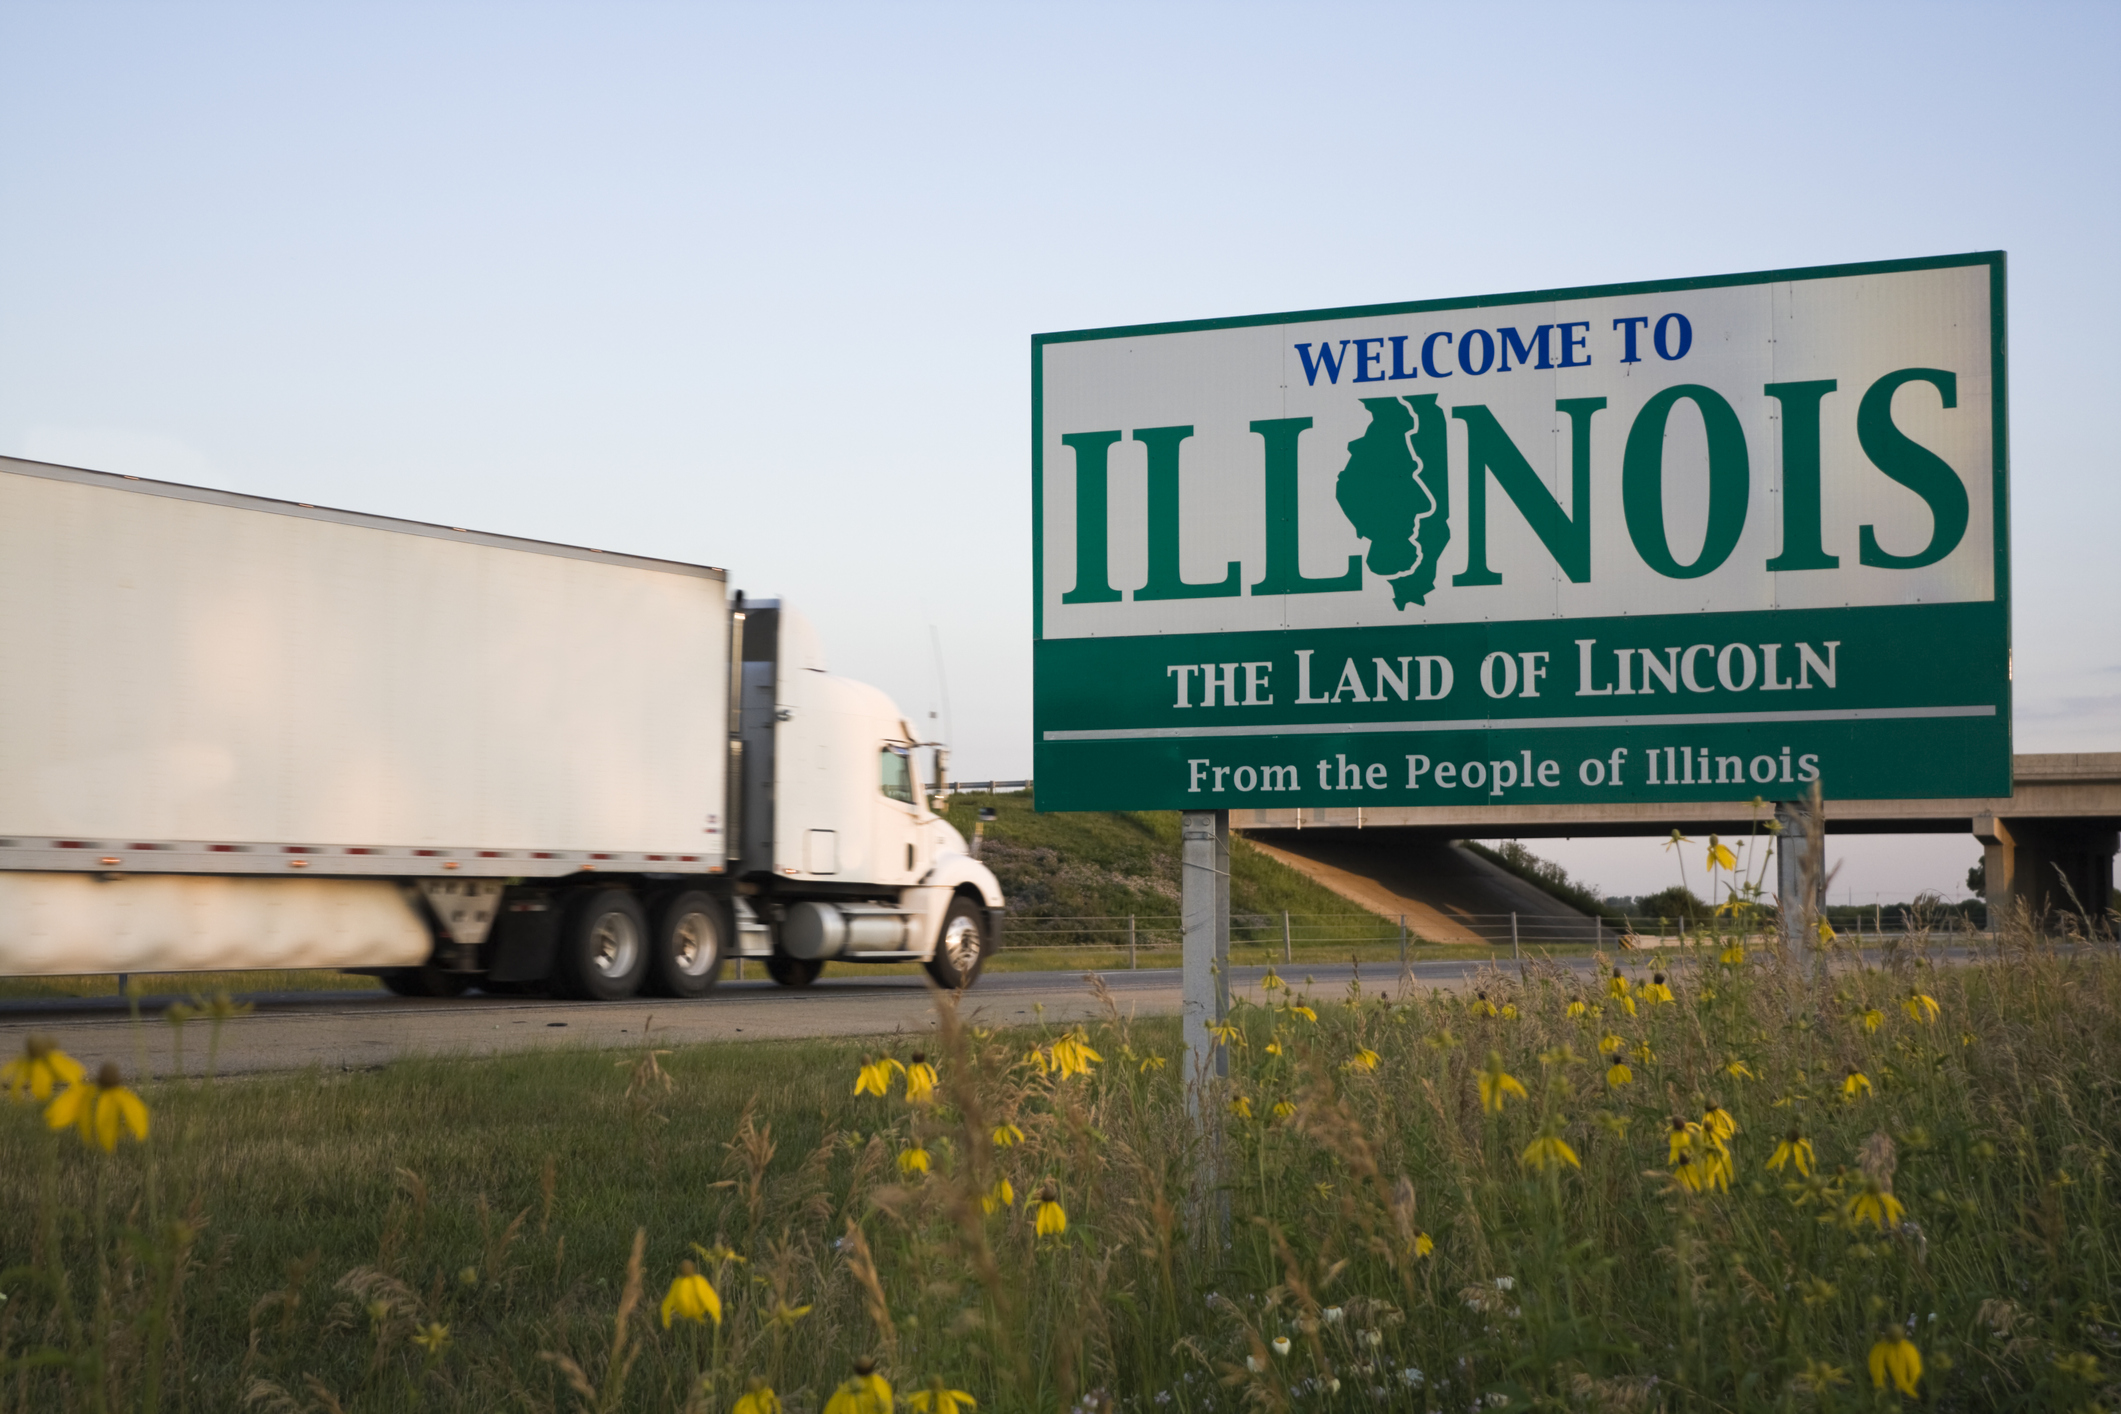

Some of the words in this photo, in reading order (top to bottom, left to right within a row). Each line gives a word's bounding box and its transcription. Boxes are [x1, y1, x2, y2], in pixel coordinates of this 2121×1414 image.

[1294, 322, 1592, 387] WELCOME
[1612, 313, 1693, 364] TO
[1061, 368, 1970, 611] ILLINOIS
[1166, 662, 1274, 709] THE
[1293, 650, 1455, 705] LAND
[1479, 651, 1550, 699] OF
[1574, 639, 1841, 697] LINCOLN
[1187, 759, 1301, 793] From
[1316, 753, 1388, 791] the
[1405, 750, 1560, 796] People
[1578, 747, 1628, 787] of
[1645, 746, 1821, 786] Illinois
